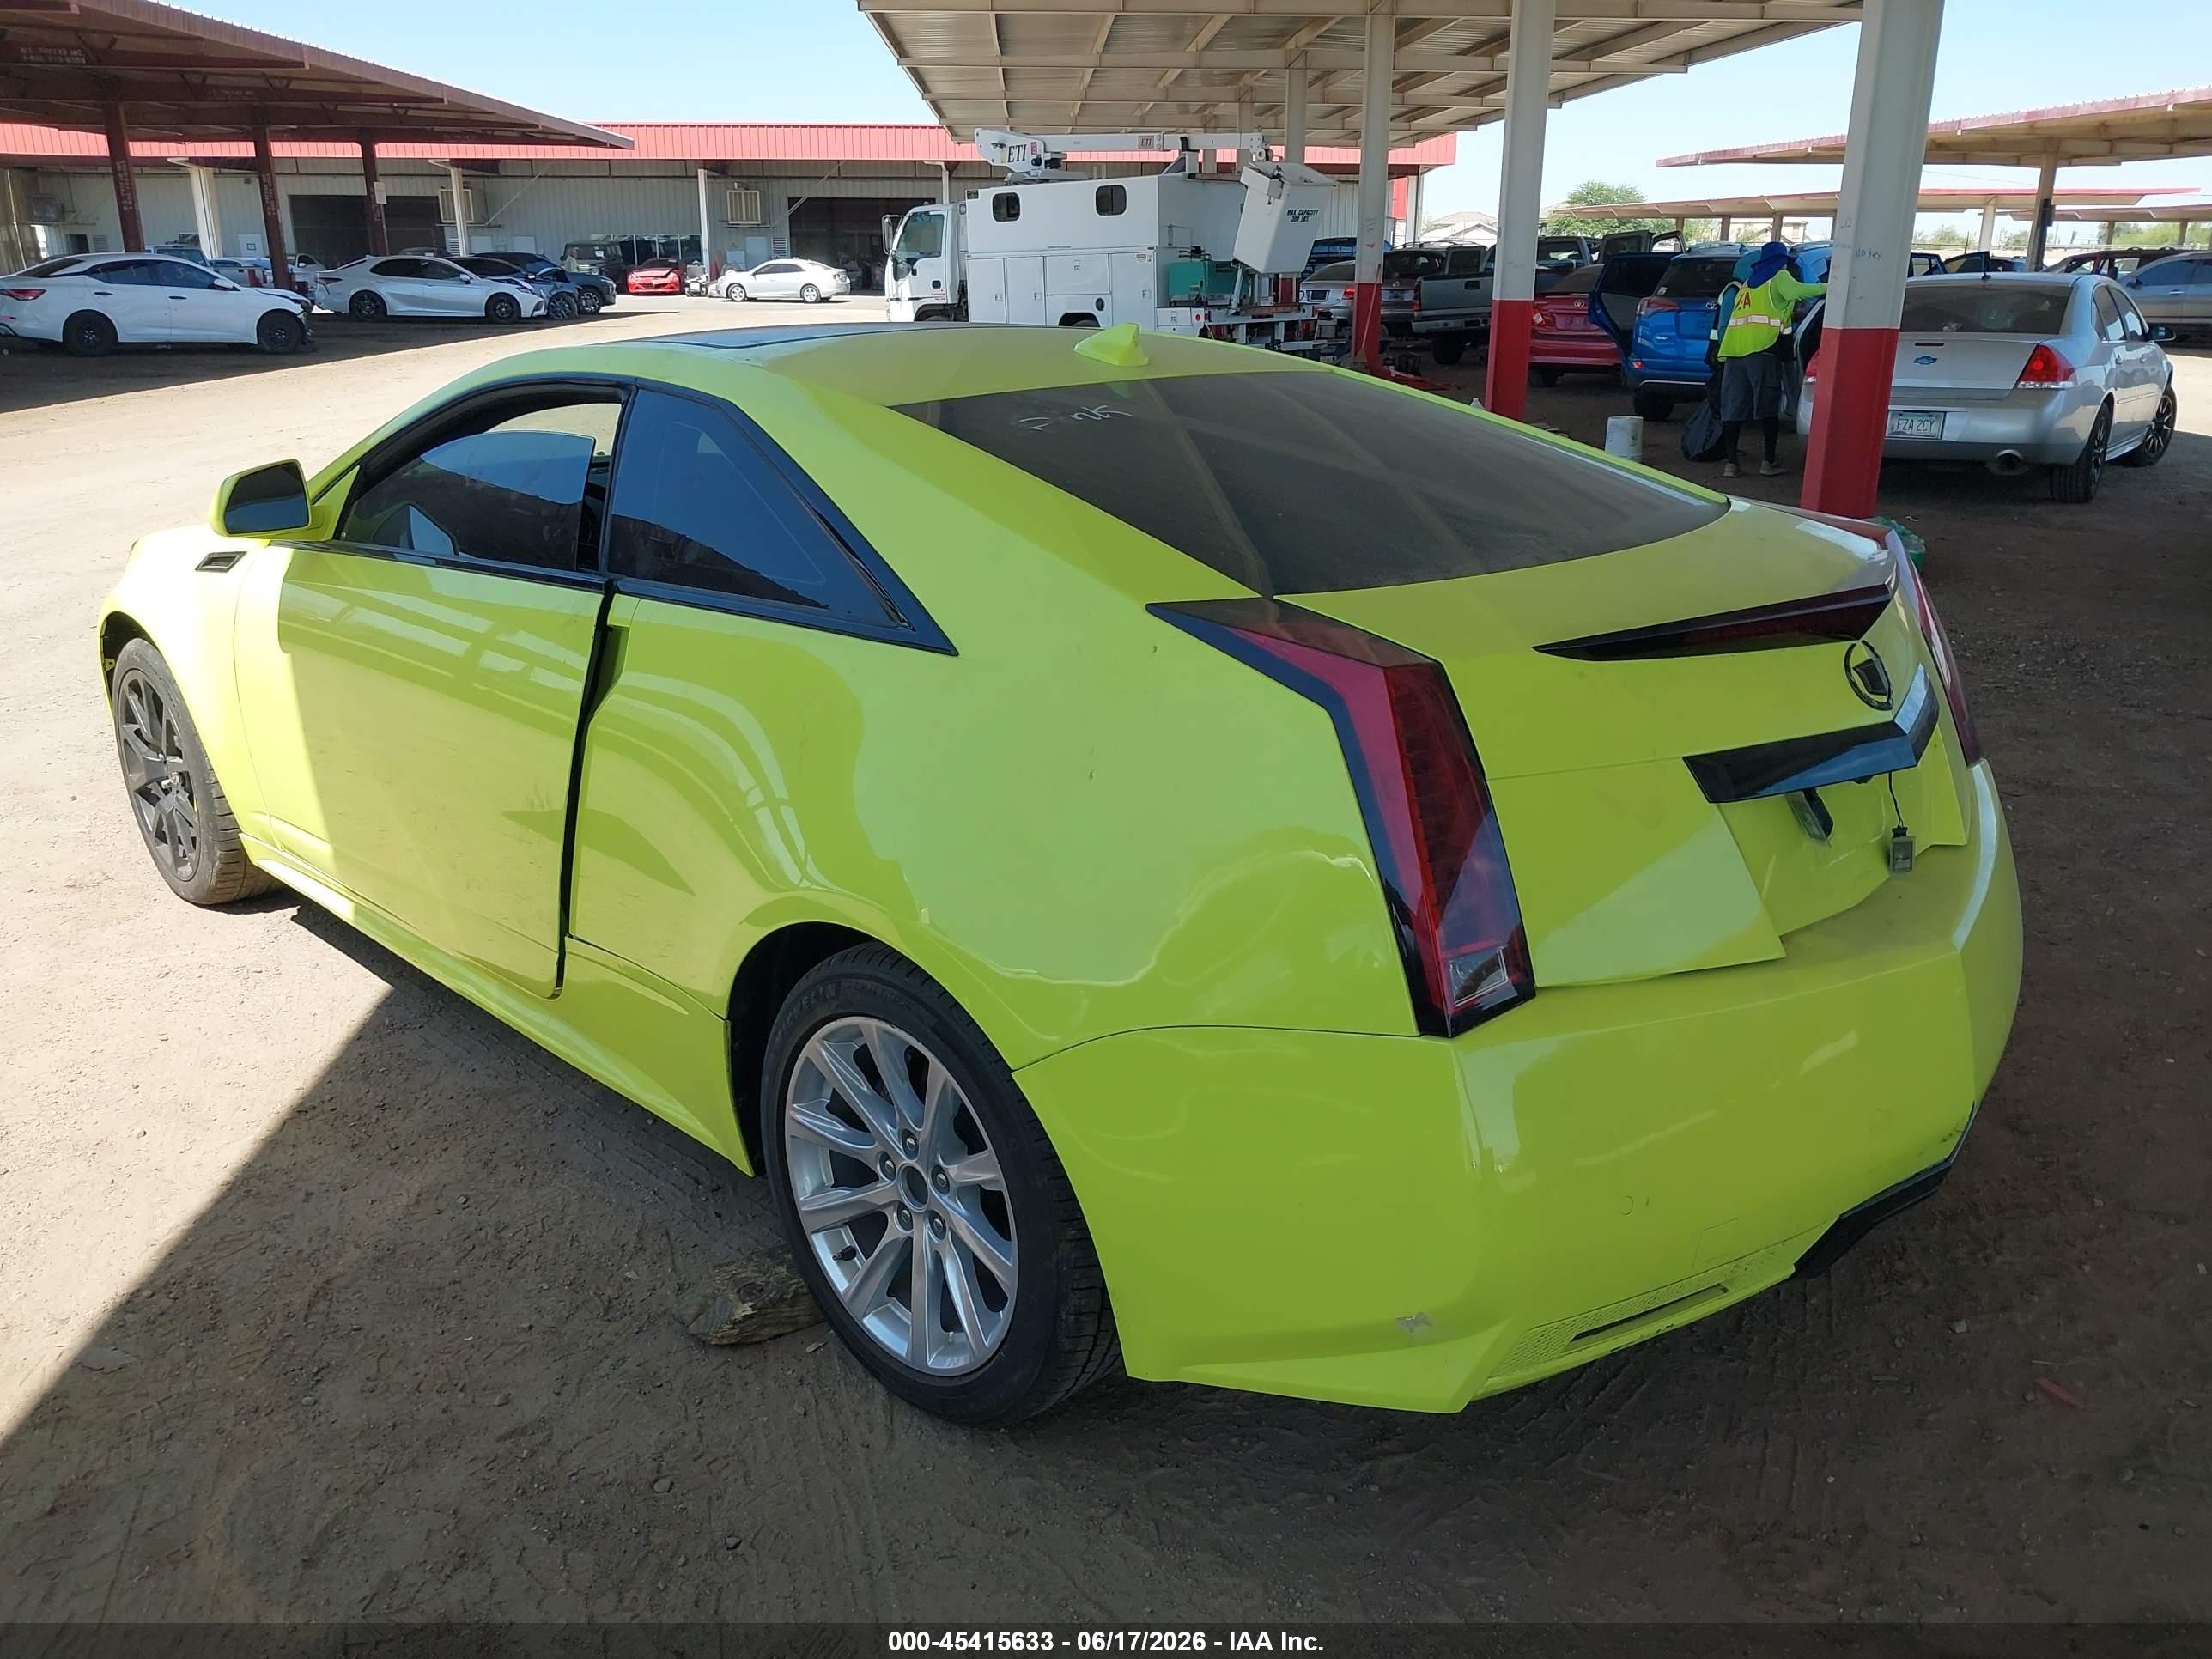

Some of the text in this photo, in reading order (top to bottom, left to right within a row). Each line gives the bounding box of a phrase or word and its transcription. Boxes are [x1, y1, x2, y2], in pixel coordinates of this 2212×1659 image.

[1141, 137, 1152, 147] ETI
[1007, 143, 1027, 163] ETI
[1896, 418, 1936, 432] FZA 2CY
